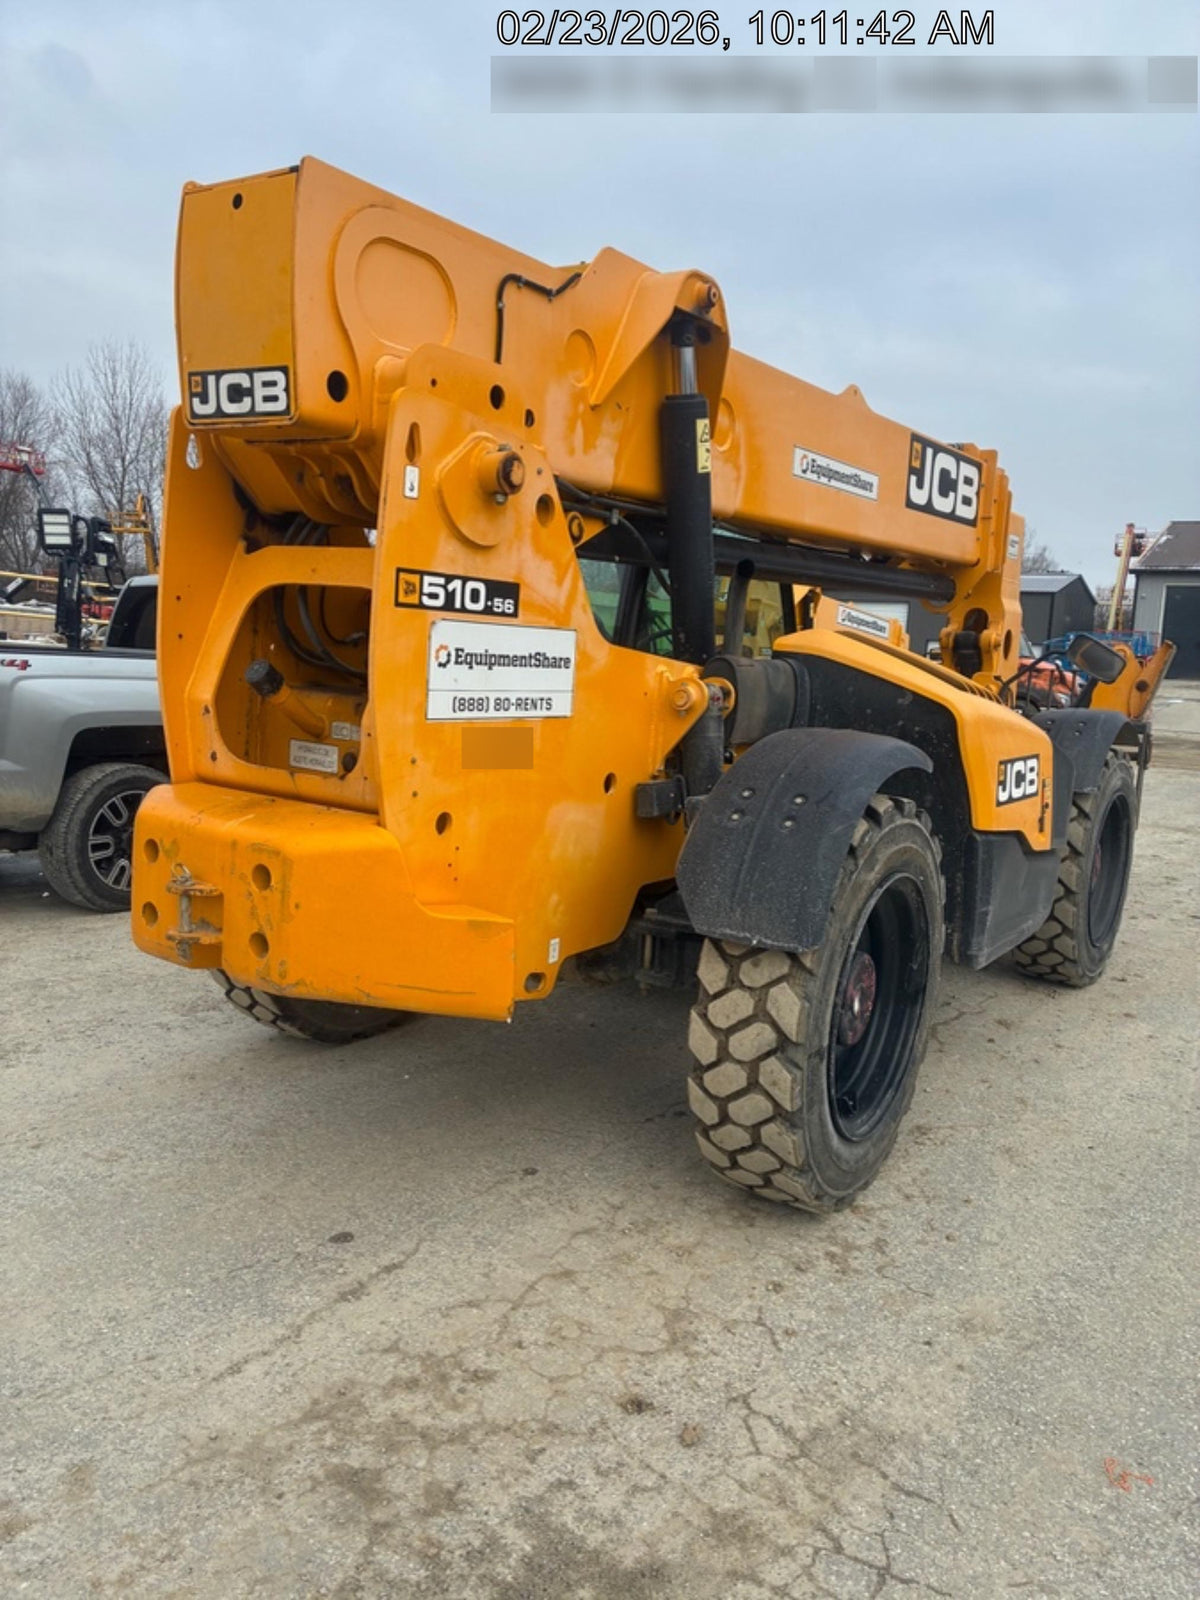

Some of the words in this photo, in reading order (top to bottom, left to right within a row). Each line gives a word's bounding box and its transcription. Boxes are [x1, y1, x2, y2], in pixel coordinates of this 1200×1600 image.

[191, 370, 288, 415] JCB
[810, 458, 874, 493] EquipmentShare
[909, 446, 980, 520] JCB
[453, 647, 571, 670] EquipmentShare
[452, 696, 490, 713] (888)
[493, 697, 553, 712] 80-RENTS
[998, 758, 1038, 803] JCB
